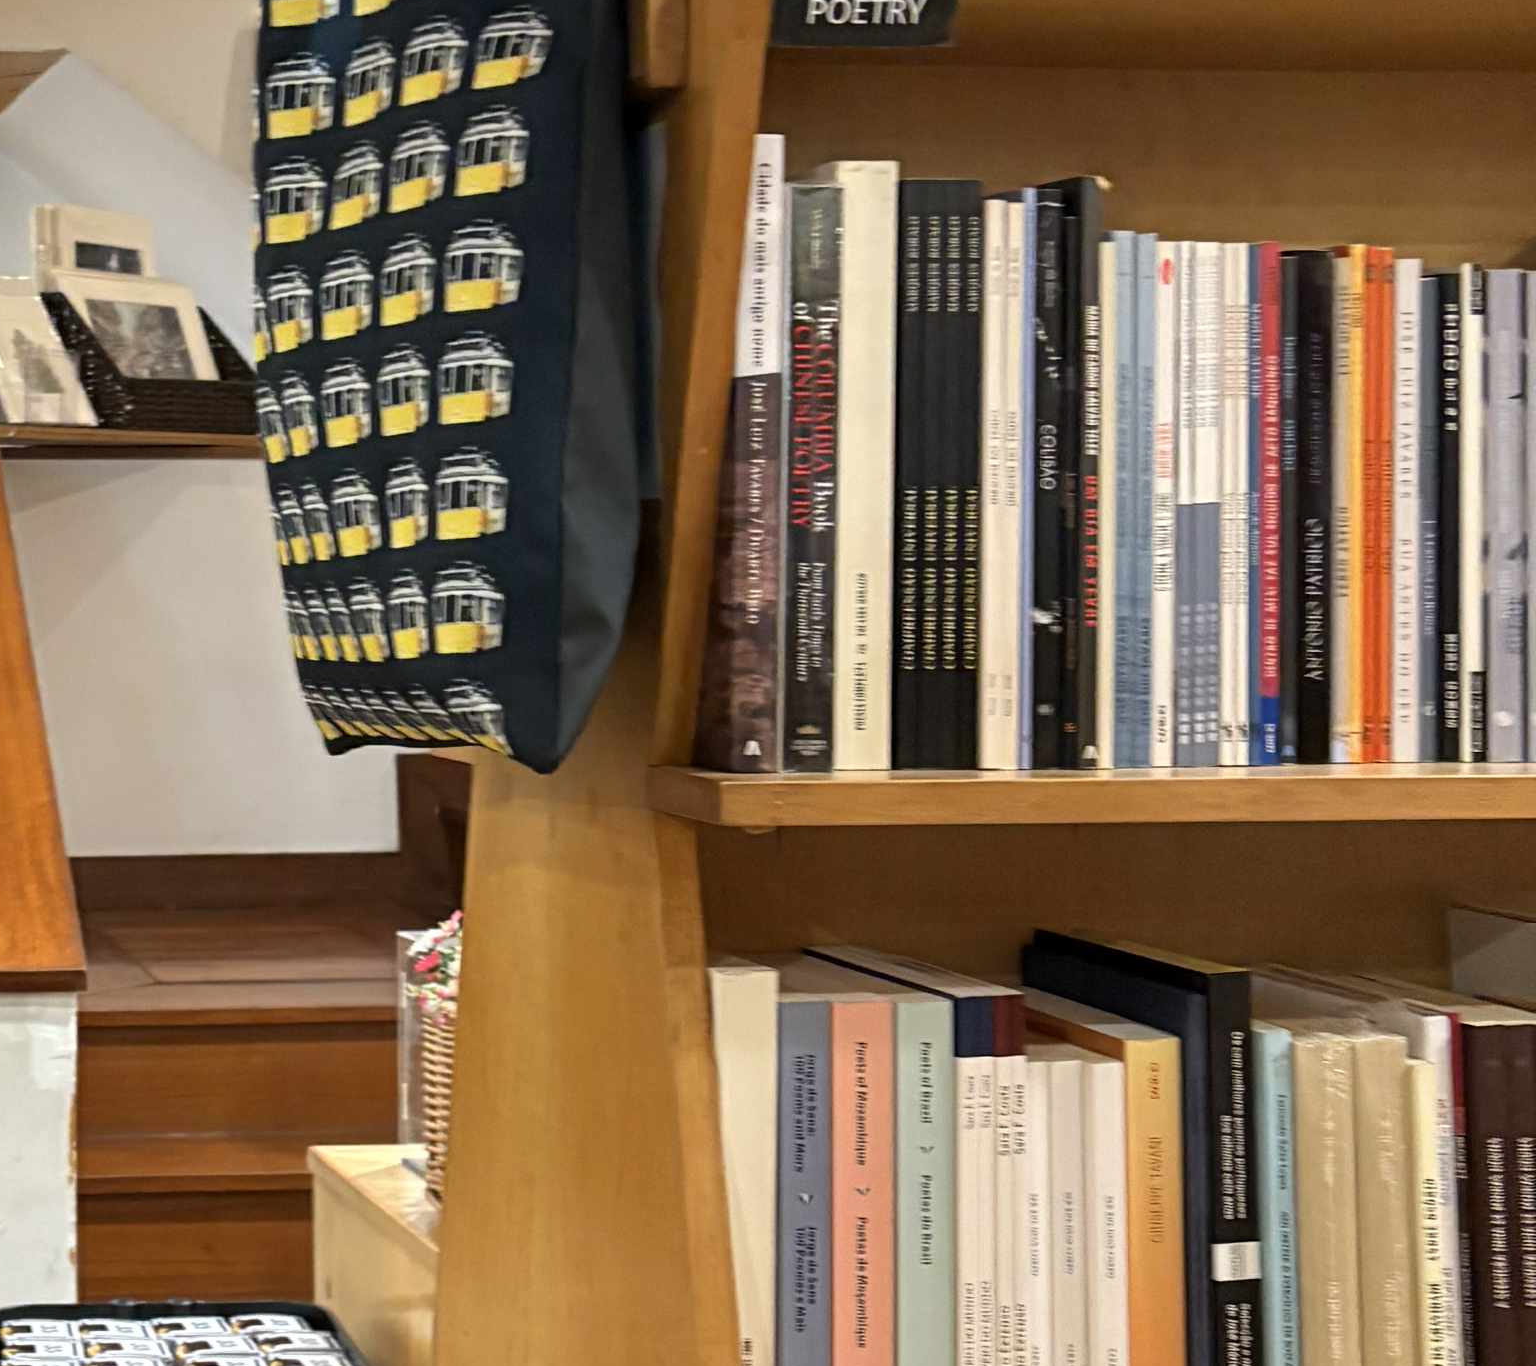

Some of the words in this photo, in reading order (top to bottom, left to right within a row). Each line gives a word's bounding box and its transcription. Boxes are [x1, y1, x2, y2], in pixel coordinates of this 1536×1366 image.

[758, 163, 773, 213] Cidade
[755, 218, 773, 236] do
[755, 242, 772, 274] mais
[750, 278, 771, 324] antigo
[792, 301, 815, 322] of
[816, 299, 840, 341] The
[1084, 305, 1100, 337] MARIA
[751, 329, 765, 368] nome
[1084, 339, 1100, 352] DO
[791, 326, 813, 426] CHINESE
[1084, 354, 1101, 388] CARMO
[812, 343, 837, 474] COLUMBIA
[790, 436, 811, 528] POETRY
[811, 480, 834, 533] Book
[1302, 518, 1325, 596] PATRÍCIO
[1302, 601, 1325, 681] ANTÓNIO
[794, 1055, 805, 1075] 100
[804, 1054, 817, 1086] Jorge
[856, 1042, 868, 1074] Poets
[920, 1042, 933, 1073] Poets
[1232, 1047, 1245, 1068] cem
[793, 1077, 805, 1115] Poems
[807, 1088, 818, 1102] de
[856, 1076, 869, 1089] of
[920, 1076, 933, 1089] of
[1232, 1069, 1246, 1116] melhores
[920, 1091, 934, 1124] Brazil
[999, 1085, 1010, 1116] Costa
[794, 1118, 806, 1140] and
[854, 1090, 869, 1166] Mozambique
[1232, 1117, 1247, 1156] poemas
[794, 1143, 806, 1173] More
[999, 1133, 1011, 1157] Sara
[1148, 1137, 1164, 1181] TAVANI
[920, 1173, 934, 1213] Poetas
[1222, 1173, 1234, 1194] cem
[1233, 1158, 1248, 1219] portugueses
[921, 1215, 934, 1230] do
[1149, 1186, 1165, 1244] GIUSEPPE
[1222, 1196, 1234, 1220] anos
[794, 1227, 807, 1247] 100
[804, 1226, 818, 1257] Jorge
[856, 1217, 868, 1255] Poetas
[921, 1233, 934, 1266] Brasil
[794, 1249, 806, 1294] Poemas
[806, 1260, 818, 1275] de
[856, 1257, 868, 1272] de
[806, 1276, 818, 1305] Sena
[794, 1306, 807, 1333] Mais
[853, 1274, 869, 1348] Moçambique
[1225, 1304, 1238, 1318] de
[1227, 1320, 1239, 1340] José
